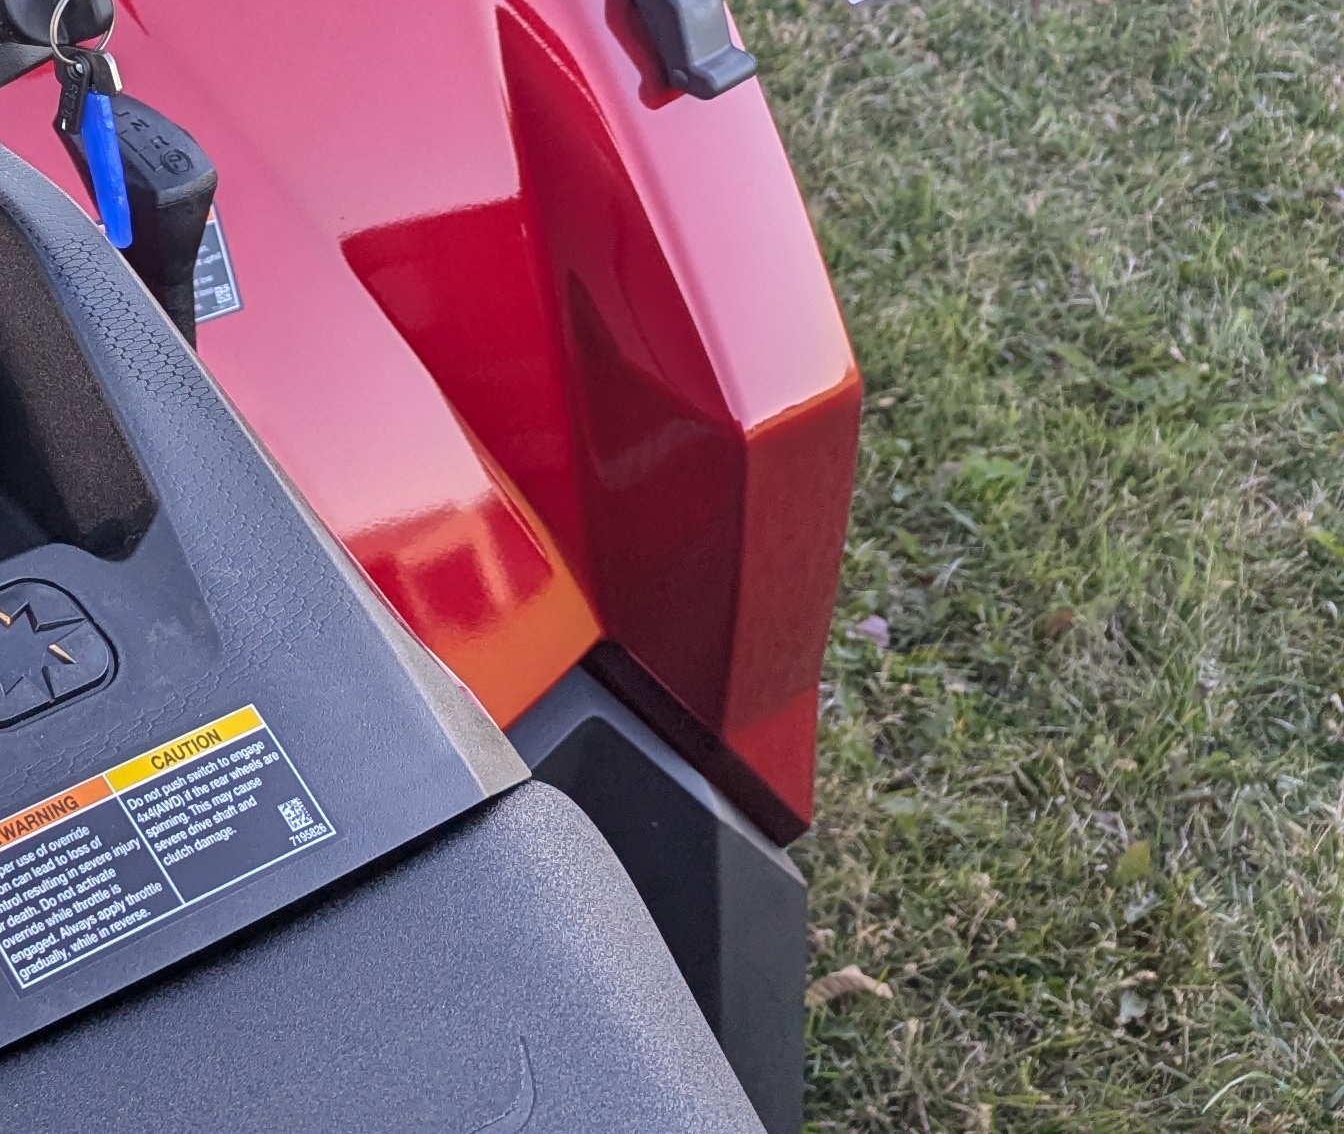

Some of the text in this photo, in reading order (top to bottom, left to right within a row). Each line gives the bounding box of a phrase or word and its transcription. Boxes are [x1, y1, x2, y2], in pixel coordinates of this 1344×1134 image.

[126, 740, 265, 810] Do not push switch to engage
[150, 728, 222, 770] CAUTION
[137, 751, 279, 823] 4x4(AWD) if the rear wheels are
[145, 777, 262, 838] spinning. This may cause
[15, 852, 36, 867] use
[35, 842, 48, 857] of
[48, 826, 90, 851] override
[153, 794, 257, 852] severe drive shaft and
[163, 826, 237, 866] clutch damage.
[288, 822, 327, 846] 7195826
[11, 871, 33, 888] can
[30, 857, 56, 877] lead
[54, 854, 68, 866] to
[66, 843, 90, 860] loss
[89, 834, 102, 849] of
[22, 873, 68, 901] resulting
[64, 867, 79, 879] in
[77, 851, 113, 873] severe
[110, 837, 141, 857] injury
[2, 883, 122, 949] override while throttle is
[6, 905, 41, 927] death.
[38, 897, 57, 911] Do
[56, 885, 77, 902] not
[75, 868, 116, 893] activate
[10, 882, 163, 963] engaged. Always apply throttle
[19, 908, 151, 981] gradually, while in reverse.
